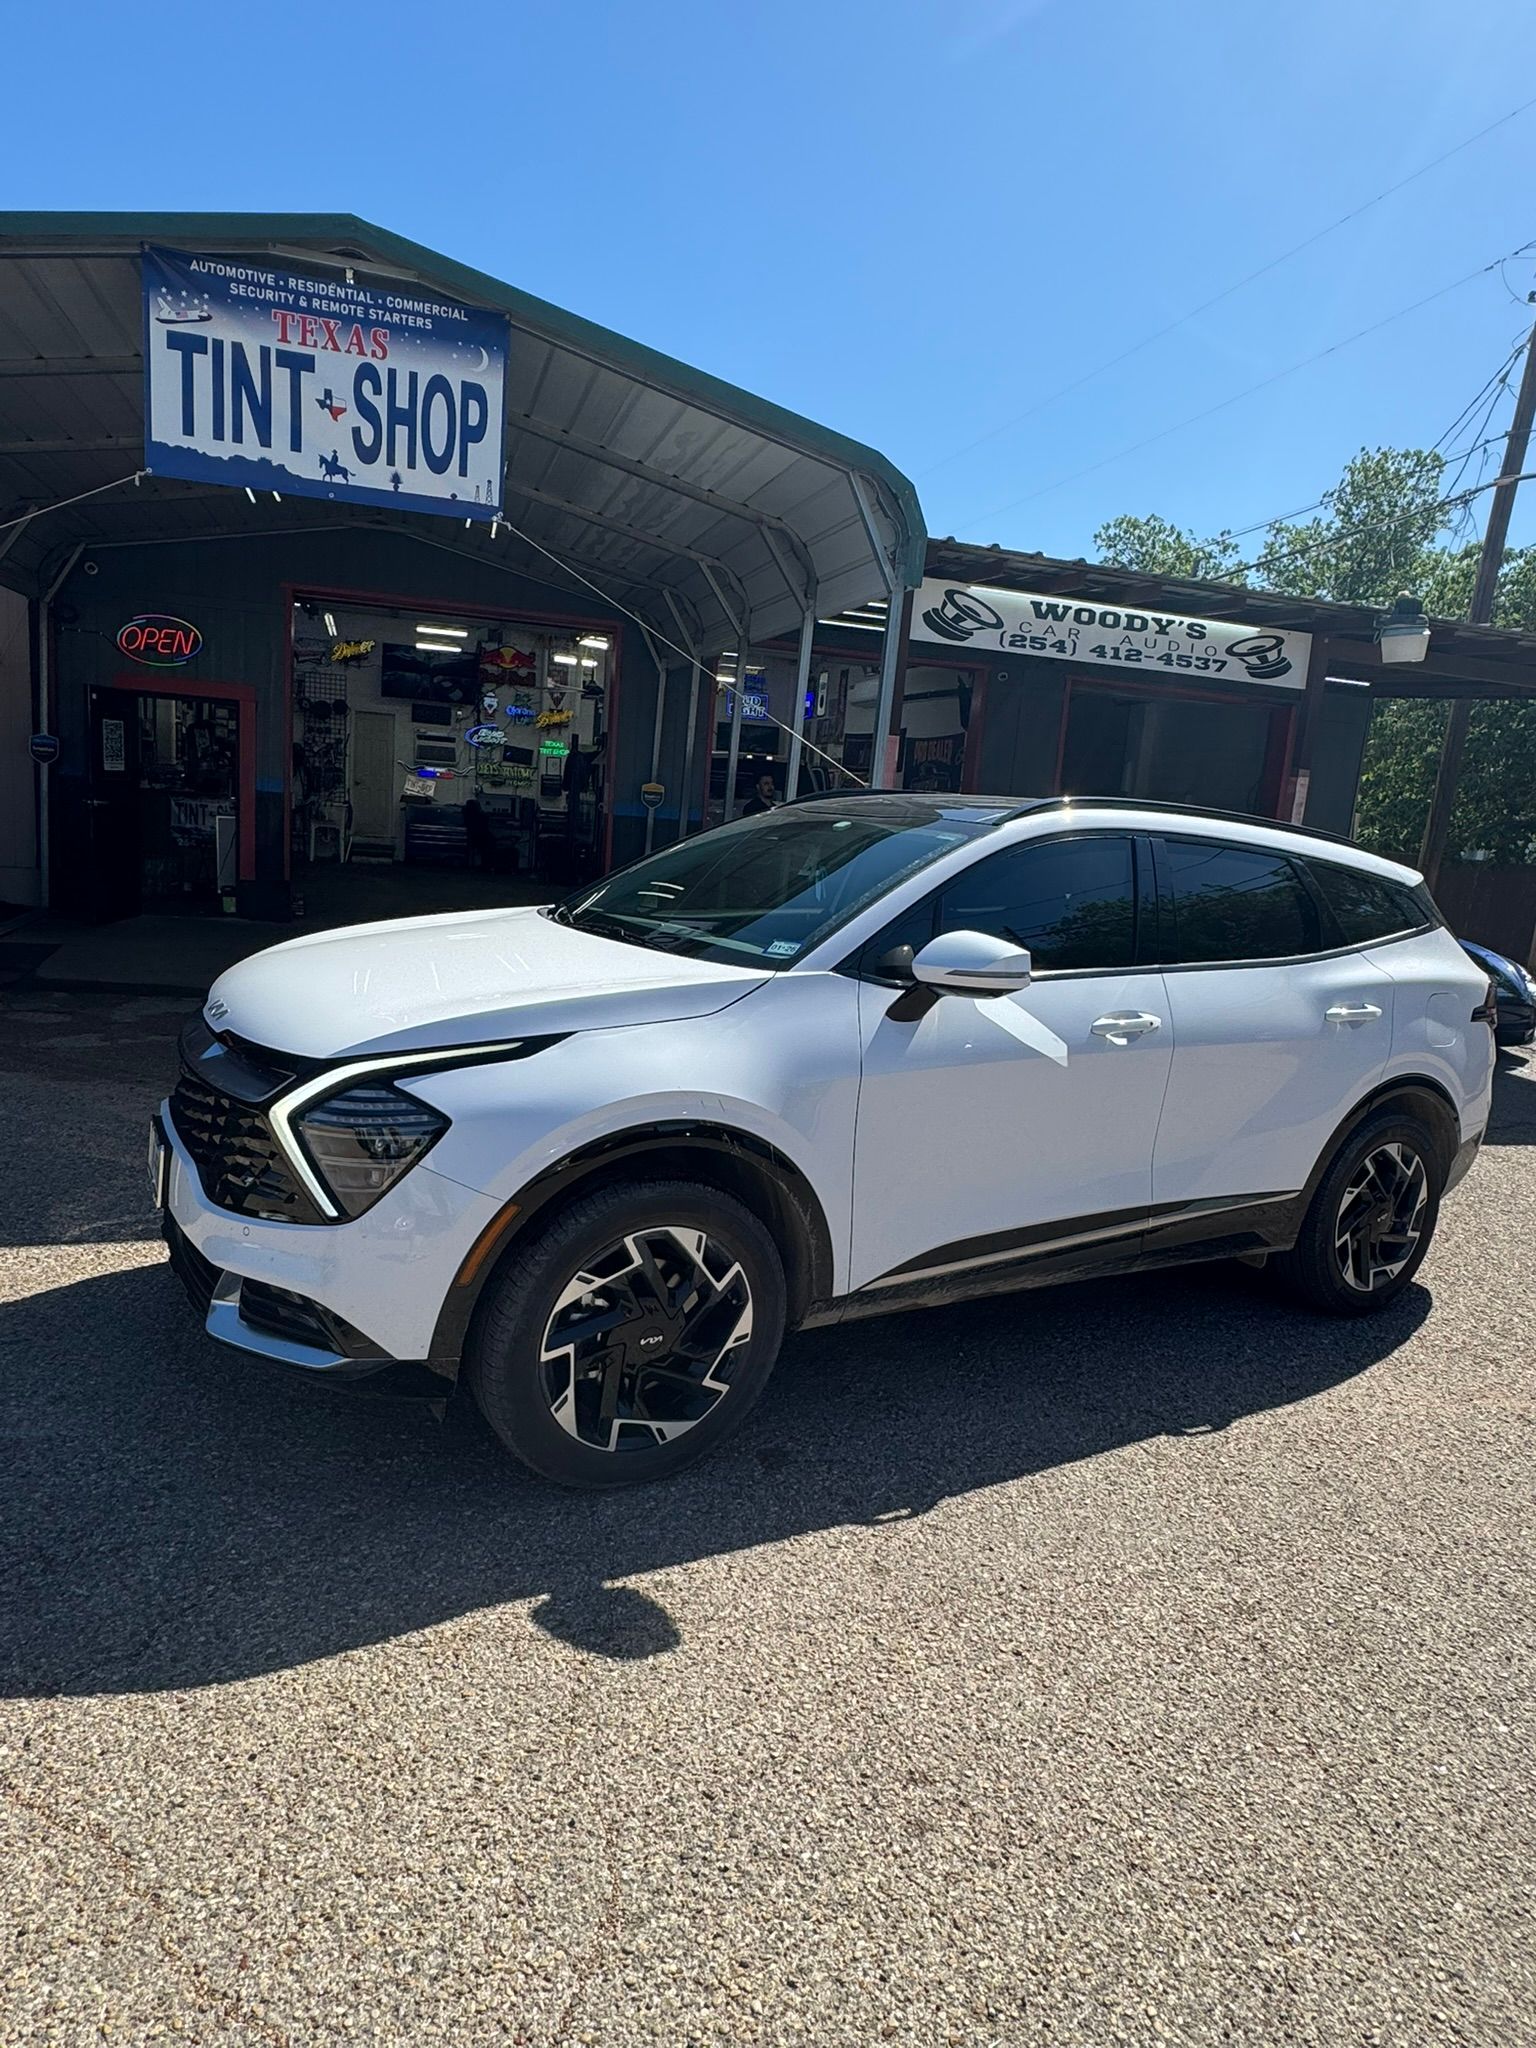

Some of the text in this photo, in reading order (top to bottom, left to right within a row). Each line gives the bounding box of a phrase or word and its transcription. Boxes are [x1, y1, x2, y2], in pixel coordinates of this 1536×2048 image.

[189, 259, 469, 321] AUTOMOTIVE RESIDENTIAL COMMERCIAL
[229, 282, 433, 330] SECURITY & REMOTE STARTERS
[271, 309, 390, 360] TEXAS
[166, 329, 489, 478] TINT SHOP
[122, 626, 195, 654] OPEN
[1019, 621, 1218, 657] CAR AUDIO
[1030, 600, 1208, 640] WOODY'S
[999, 630, 1228, 673] (254) 412-4537
[174, 802, 209, 826] TINT
